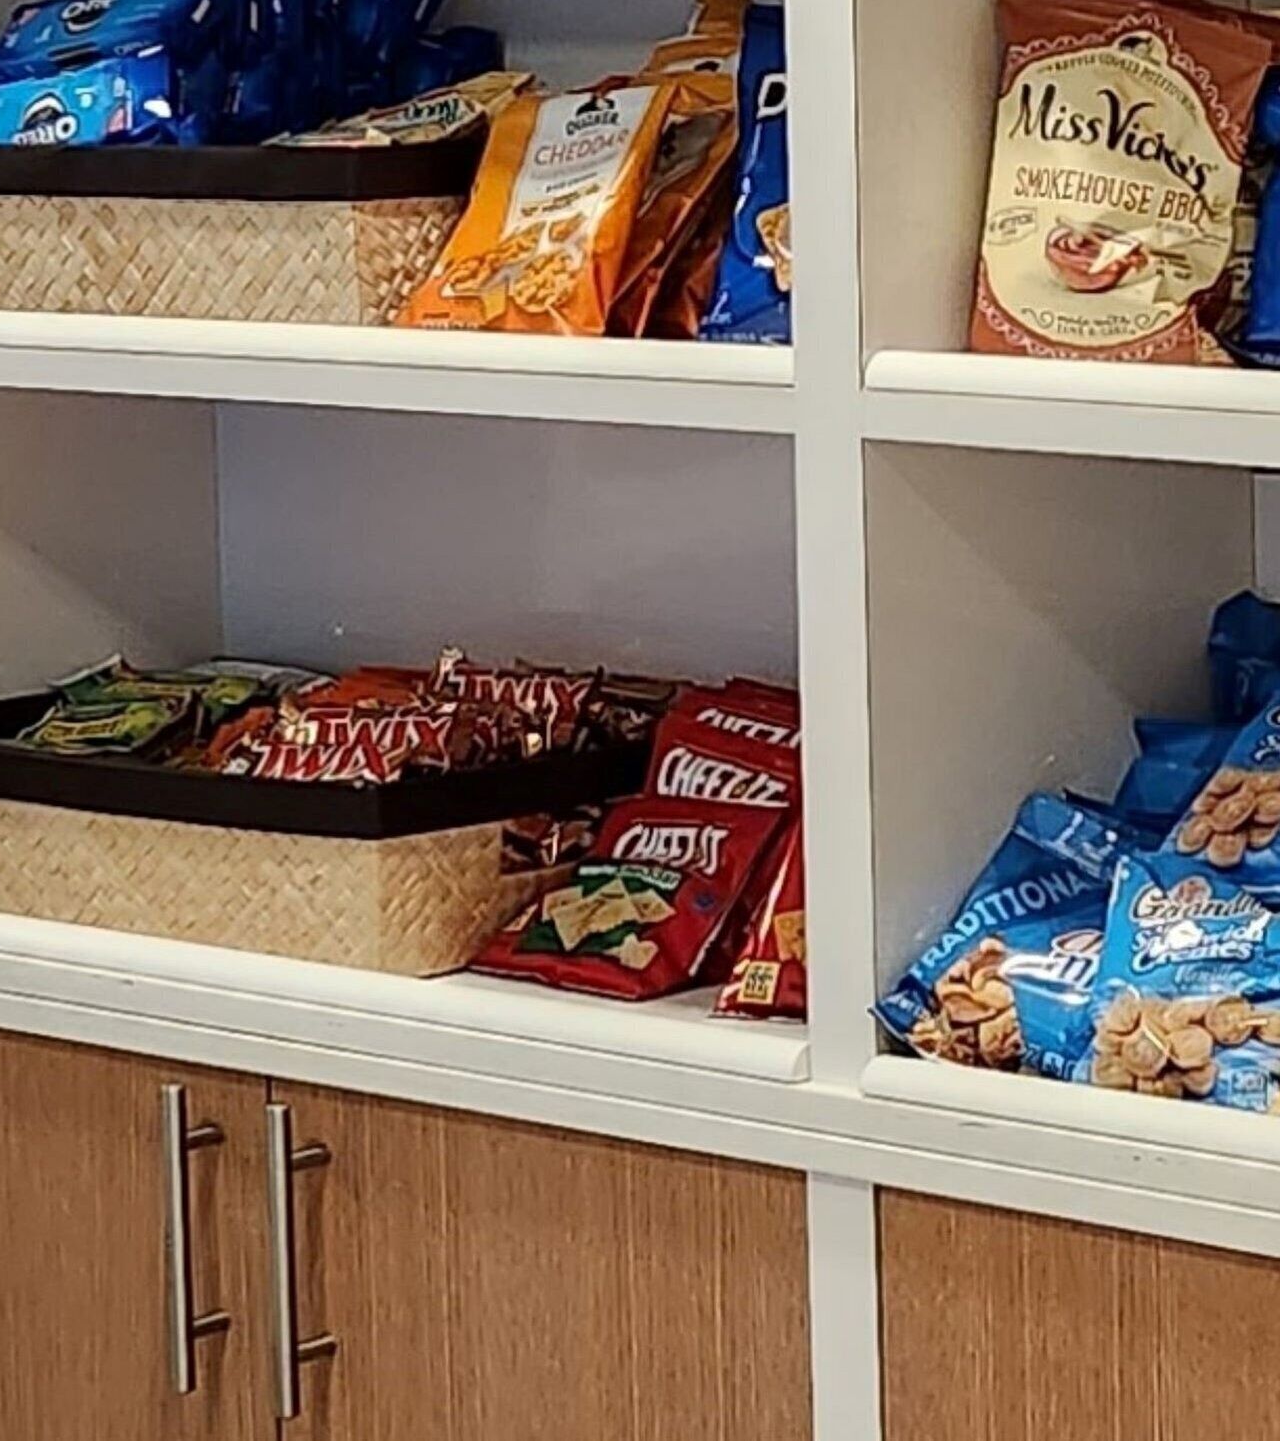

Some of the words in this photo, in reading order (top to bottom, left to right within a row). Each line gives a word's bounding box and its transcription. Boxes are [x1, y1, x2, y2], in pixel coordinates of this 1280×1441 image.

[1009, 83, 1104, 146] Miss
[534, 128, 629, 166] CHEDDAR
[1014, 165, 1154, 215] SMOKEHOUSE
[1158, 189, 1209, 233] BBQ
